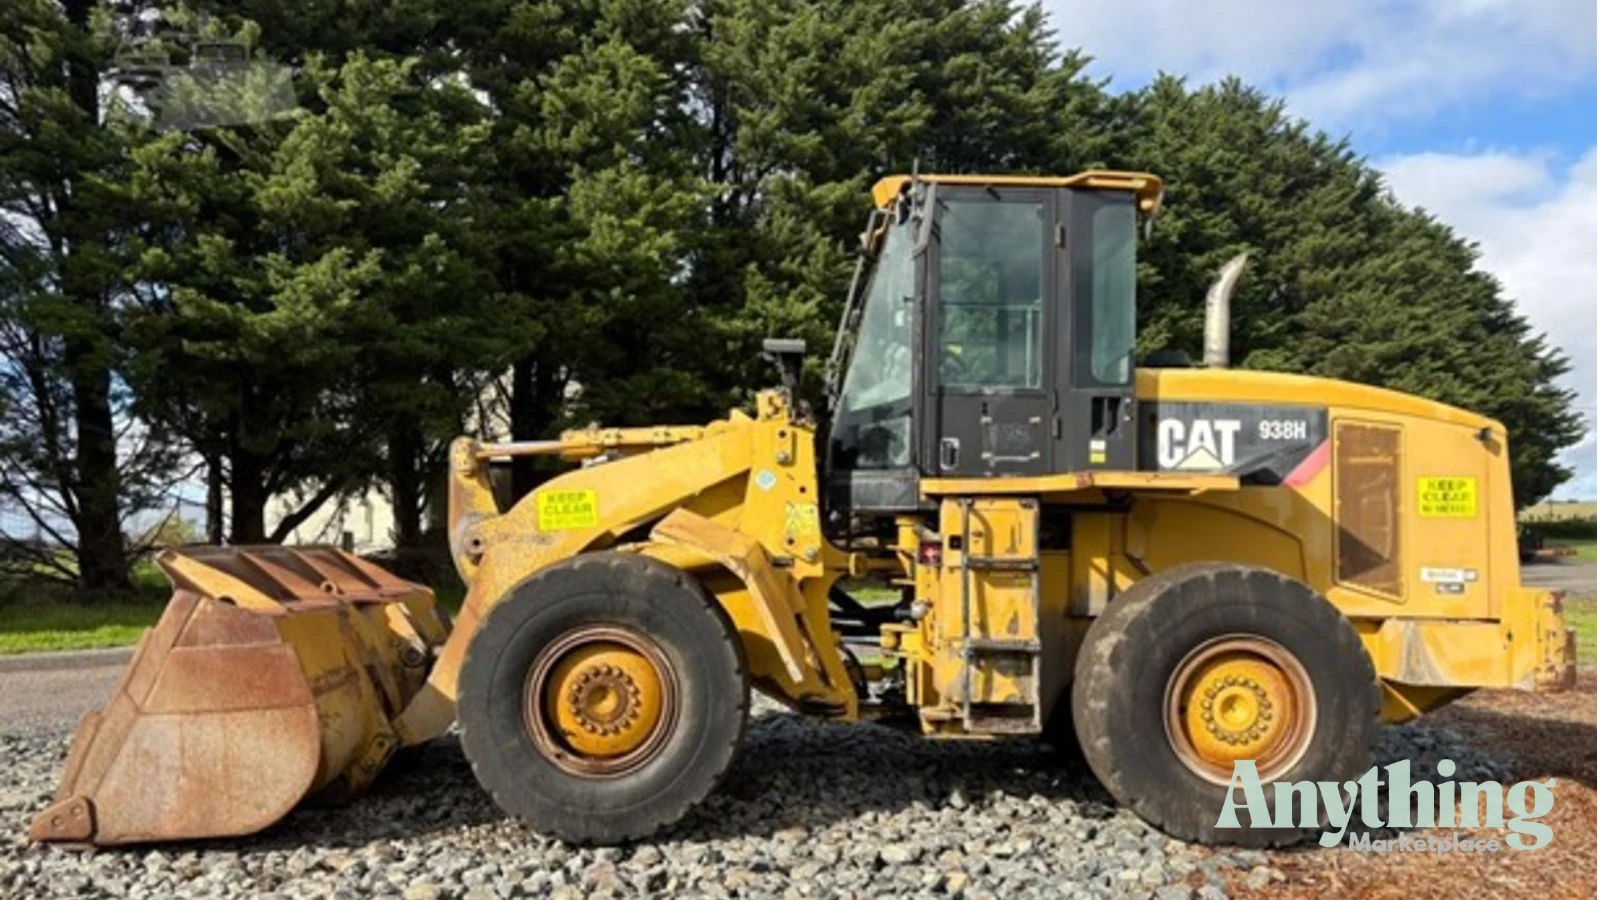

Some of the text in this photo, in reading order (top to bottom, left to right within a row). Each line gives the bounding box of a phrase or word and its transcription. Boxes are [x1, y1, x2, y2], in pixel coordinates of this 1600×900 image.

[1259, 419, 1306, 440] 938H
[1158, 418, 1241, 469] CAT
[1427, 479, 1467, 490] KEEP
[547, 492, 587, 504] KEEP
[1422, 491, 1472, 502] CLEAR
[544, 503, 592, 516] CLEAR
